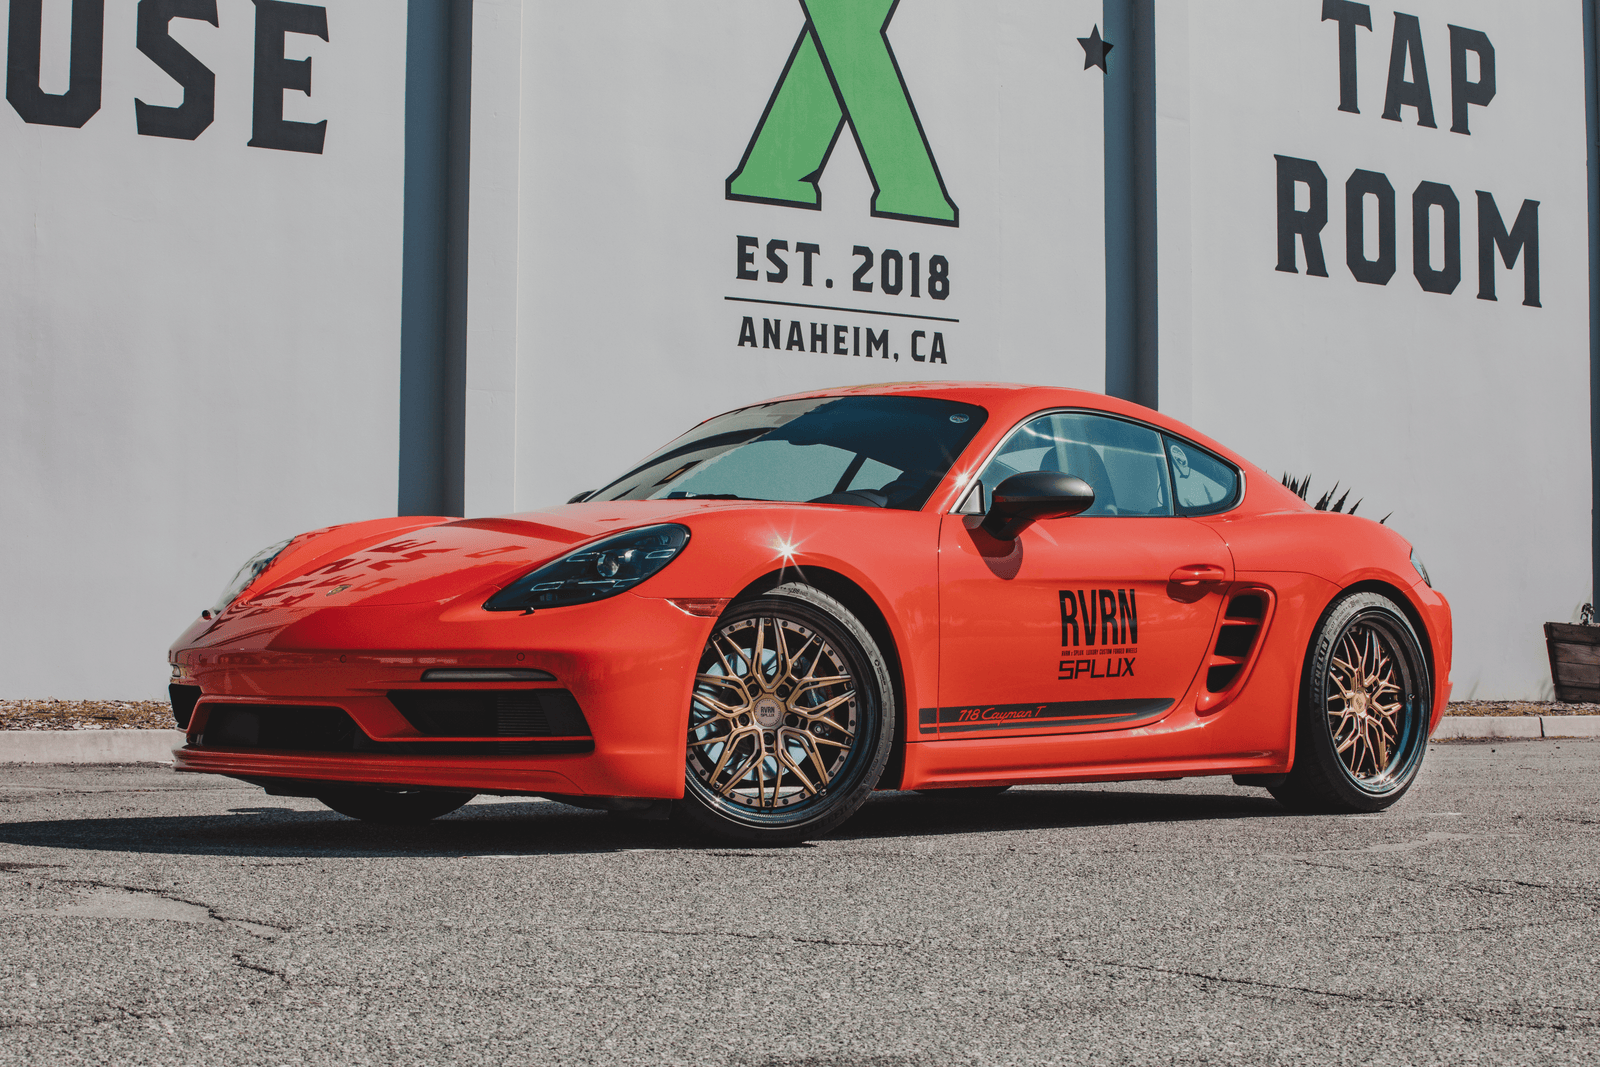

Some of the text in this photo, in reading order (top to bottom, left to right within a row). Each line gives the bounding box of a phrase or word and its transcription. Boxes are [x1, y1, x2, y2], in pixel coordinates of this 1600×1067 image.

[6, 0, 329, 154] USE
[1322, 0, 1496, 135] TAP
[1274, 154, 1542, 308] ROOM
[736, 236, 949, 300] EST. 2018
[738, 317, 947, 364] ANAHEIM, CA
[1058, 589, 1138, 647] RVRN
[1058, 657, 1136, 680] SPLUX
[959, 705, 1047, 726] 718 Cayman T
